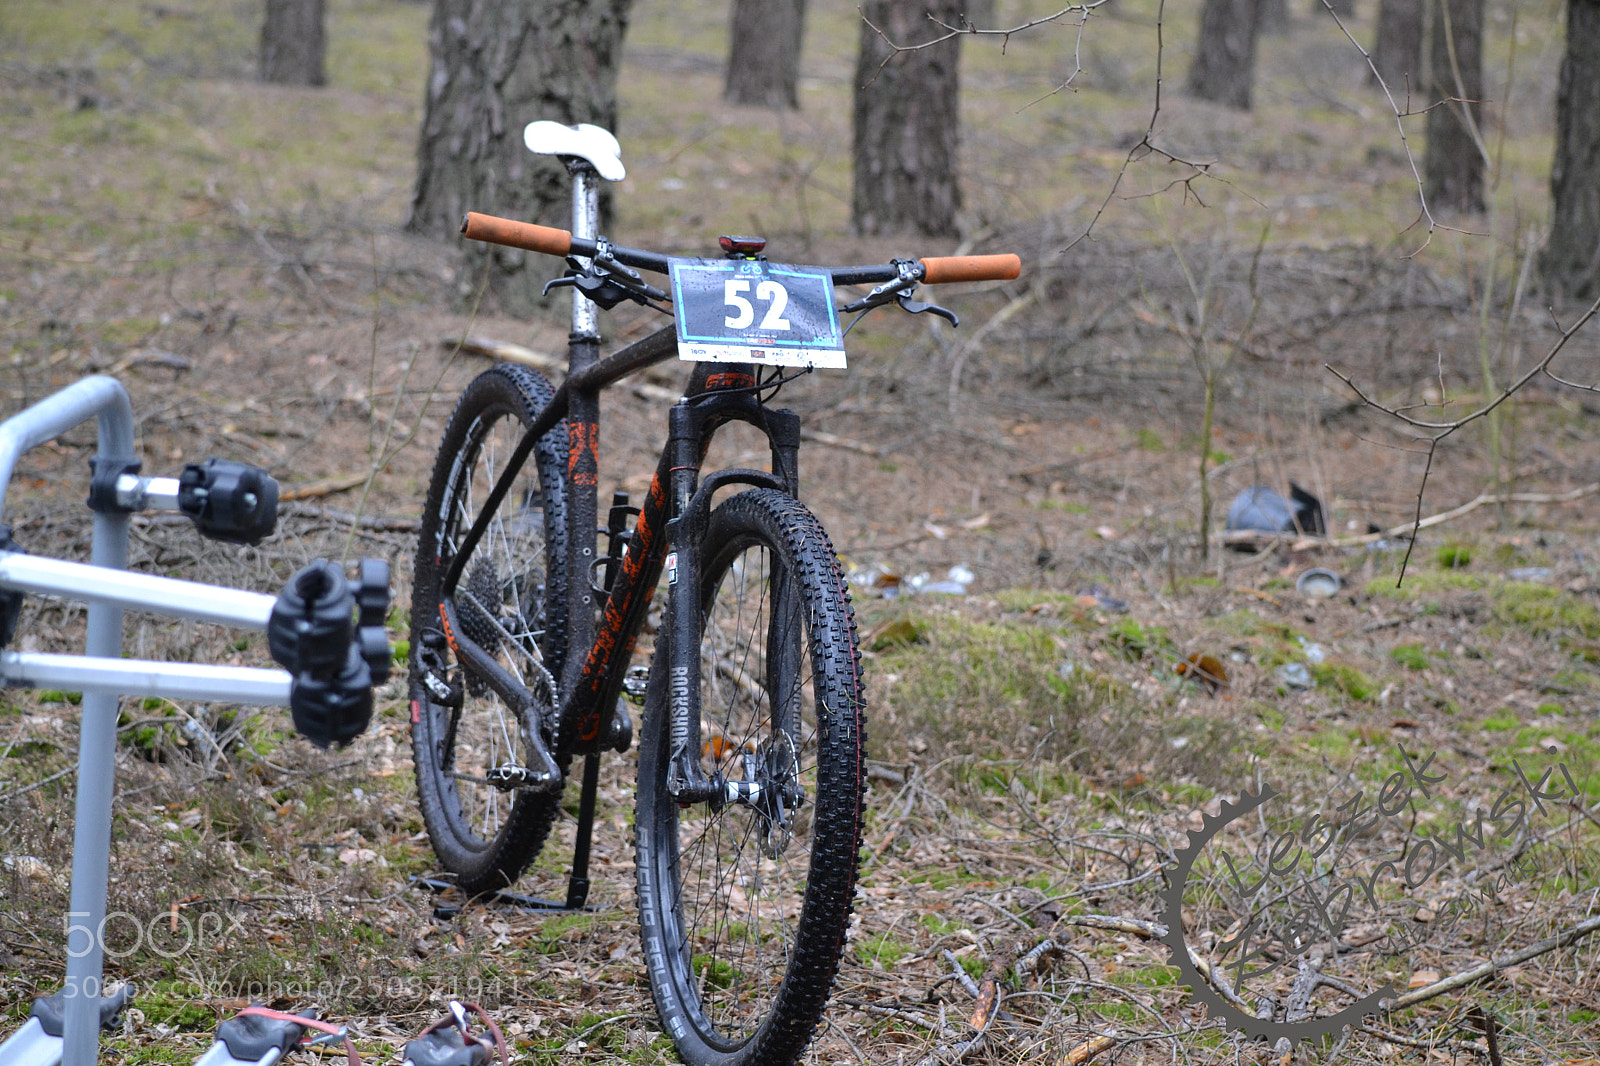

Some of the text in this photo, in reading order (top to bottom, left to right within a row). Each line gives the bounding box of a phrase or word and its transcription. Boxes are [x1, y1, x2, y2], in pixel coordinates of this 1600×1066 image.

[724, 279, 791, 331] 52
[638, 826, 676, 1012] RACING RALPH
